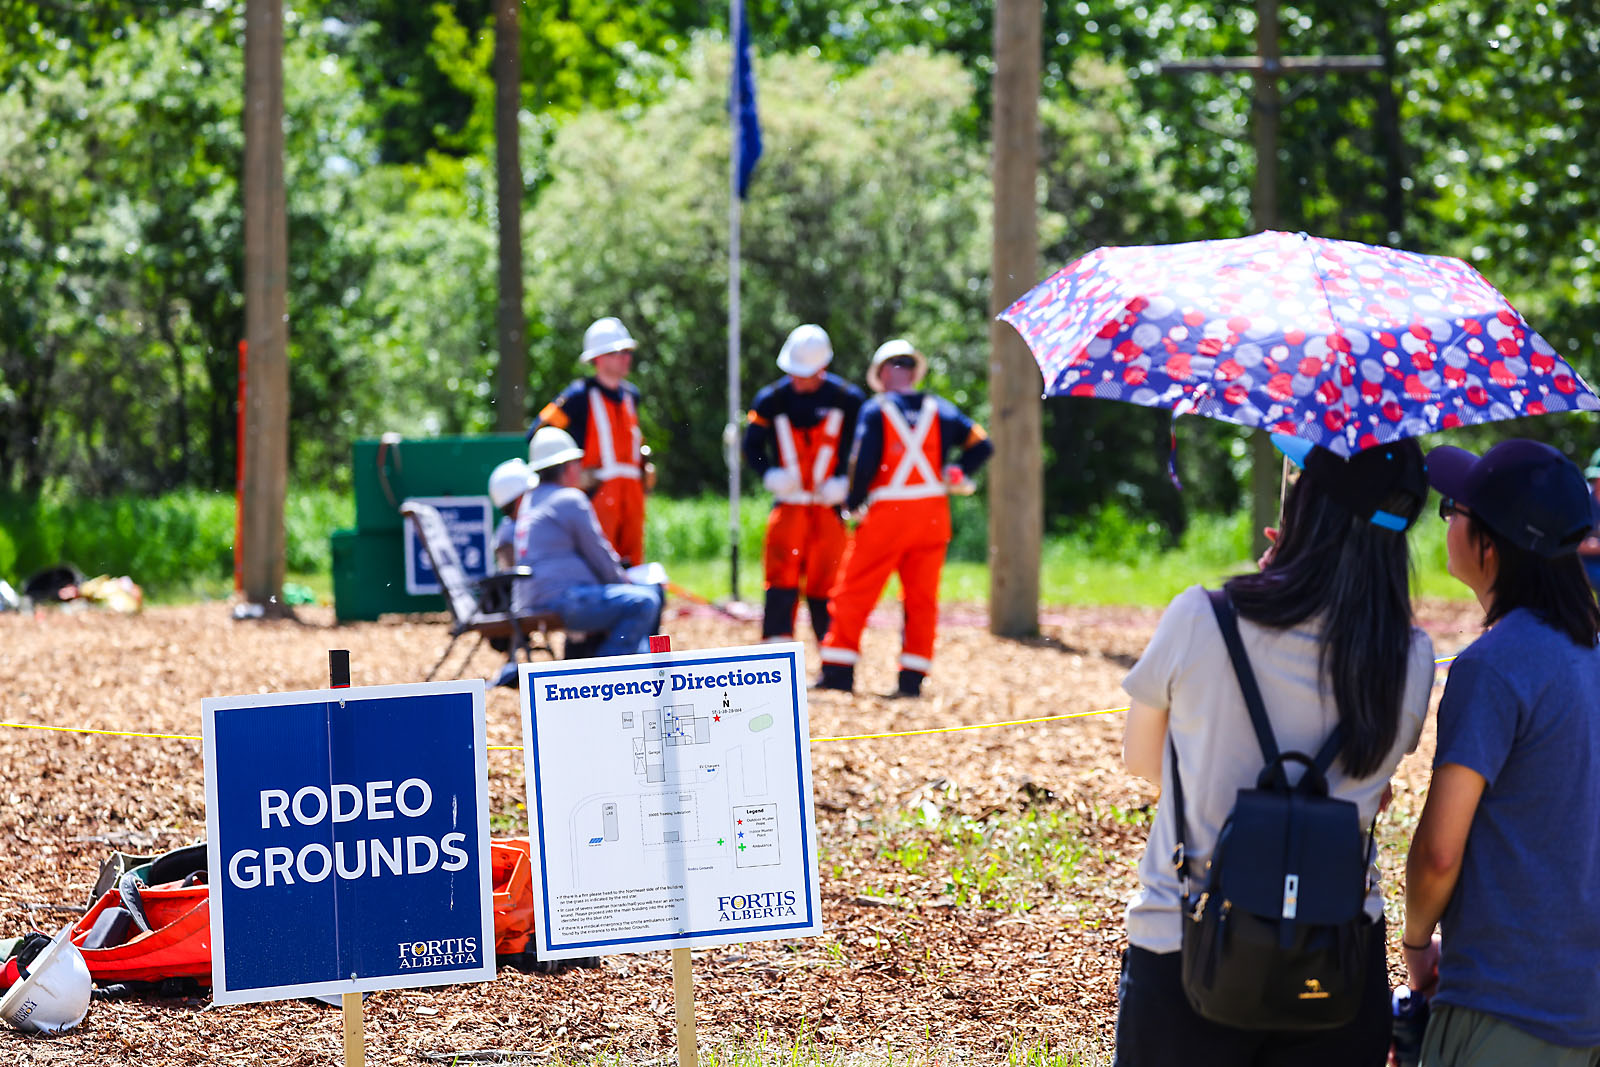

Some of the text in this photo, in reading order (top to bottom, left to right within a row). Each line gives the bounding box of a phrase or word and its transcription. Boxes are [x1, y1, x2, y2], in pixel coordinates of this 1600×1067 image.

[545, 669, 782, 702] Emergency Directions
[260, 778, 433, 829] RODEO
[228, 832, 469, 889] GROUNDS
[717, 890, 796, 911] FORTIS
[719, 906, 796, 922] ALBERTA
[398, 937, 477, 958] FORTIS
[399, 953, 477, 969] ALBERTA
